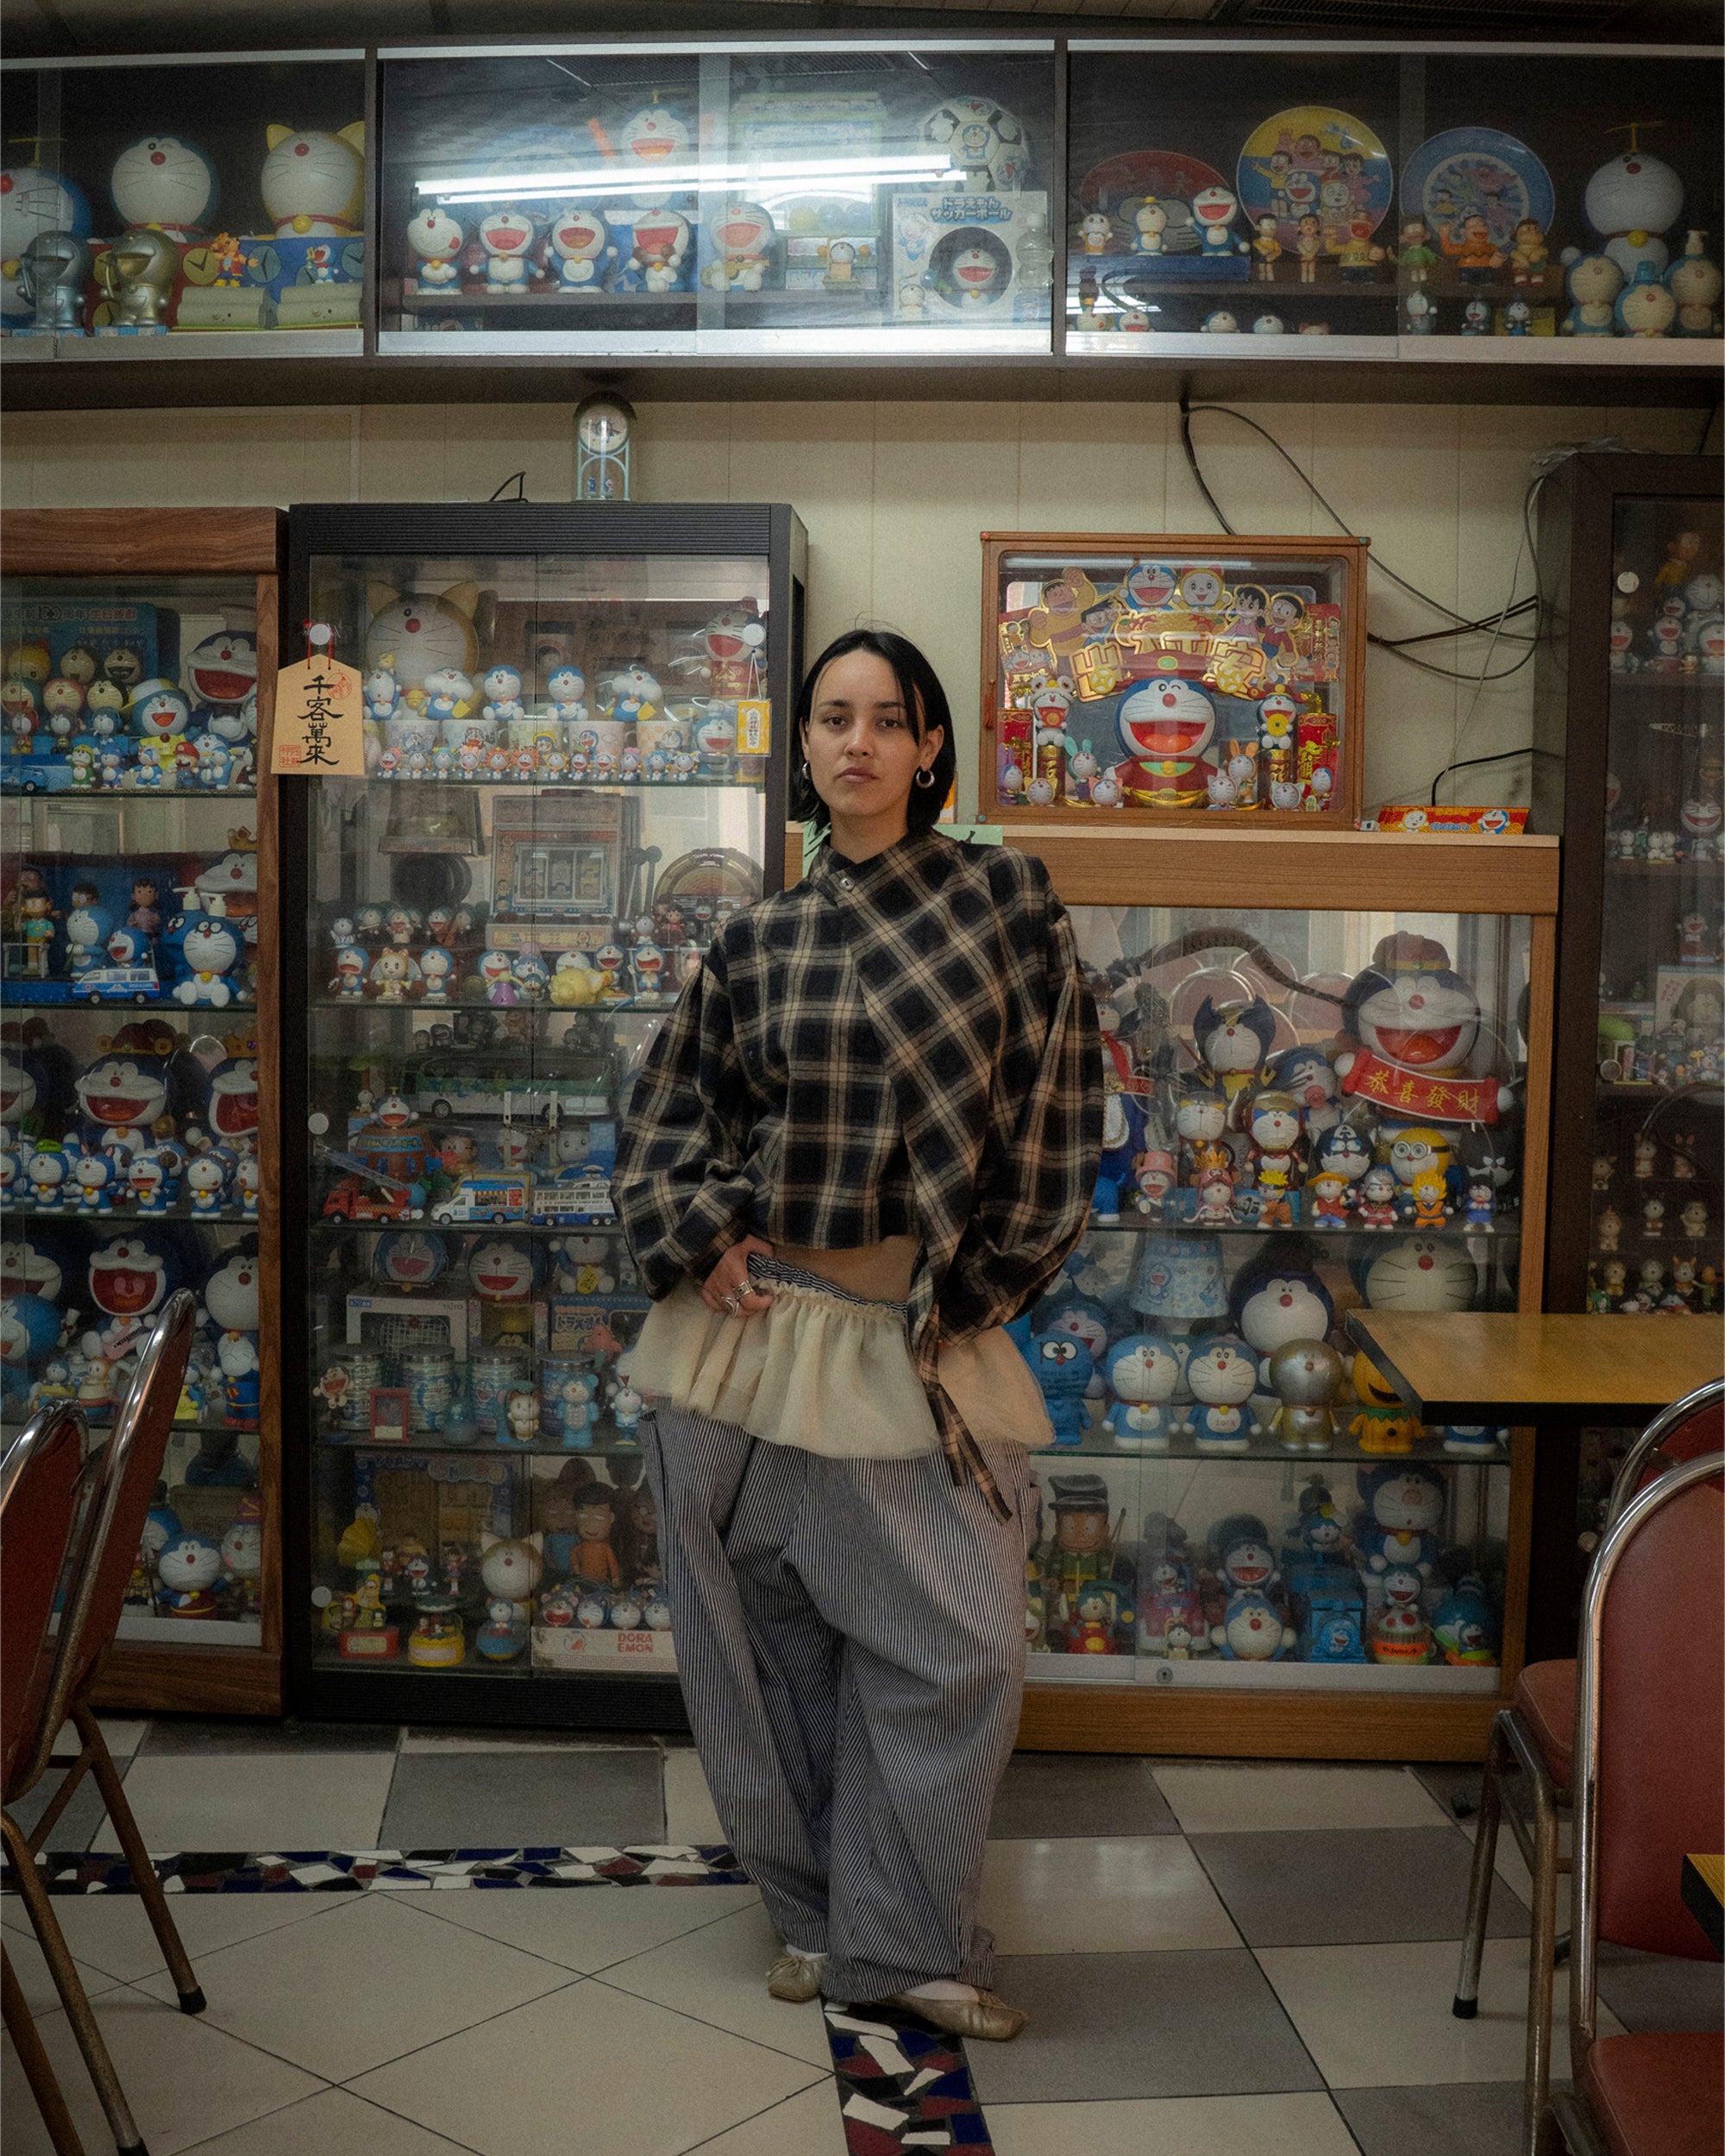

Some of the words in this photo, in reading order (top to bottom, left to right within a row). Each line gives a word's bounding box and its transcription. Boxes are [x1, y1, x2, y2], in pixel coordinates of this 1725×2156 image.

[942, 196, 1001, 210] ドラえもん
[931, 207, 1013, 222] サッカーボール
[297, 674, 343, 766] 千客萬來
[1364, 1069, 1479, 1115] 恭喜發財
[618, 1633, 653, 1643] DORA
[618, 1643, 653, 1653] EMON
